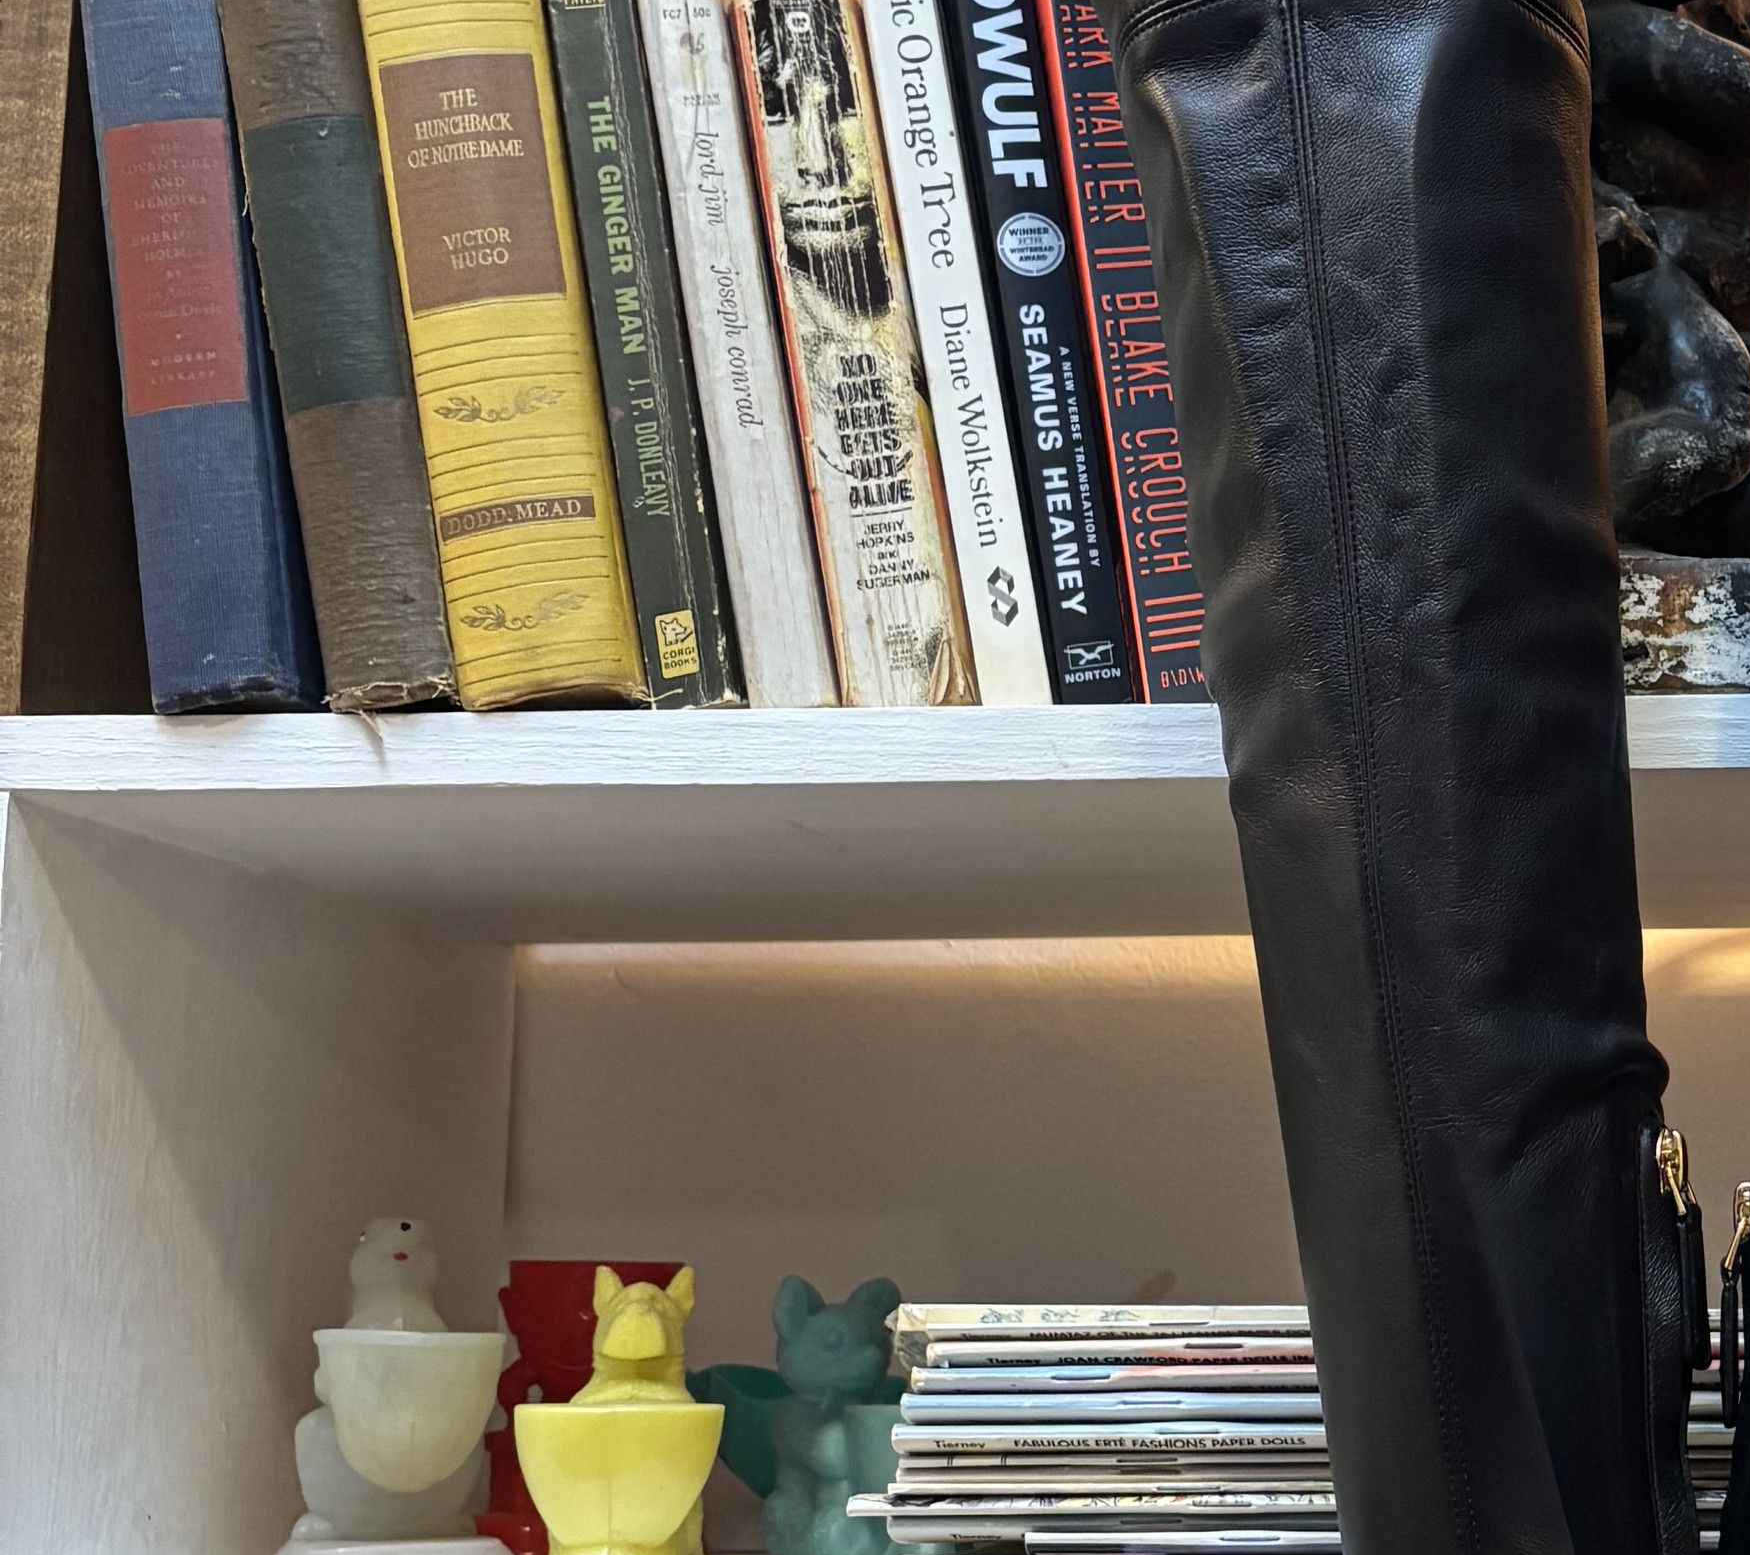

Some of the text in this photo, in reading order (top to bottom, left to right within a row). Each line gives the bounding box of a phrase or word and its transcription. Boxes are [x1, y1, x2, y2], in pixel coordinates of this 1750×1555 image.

[439, 88, 478, 110] THE
[414, 112, 514, 140] HUNCHBACK
[897, 34, 934, 169] Orange
[920, 171, 955, 269] Tree
[587, 96, 646, 355] THE GINGER MAN
[442, 227, 511, 250] VICTOR
[451, 248, 510, 270] HUGO
[940, 302, 1005, 548] Diane Wolkstein
[627, 378, 671, 517] J. P. DONLEAVY
[1019, 303, 1089, 616] SEAMUS HEANEY
[1059, 345, 1102, 568] A NEW VERSE TRANSLATION BY
[662, 646, 695, 660] CORGI
[664, 657, 697, 670] BOOKS
[1064, 667, 1122, 684] NORTON
[934, 1439, 986, 1451] Tierney
[1013, 1438, 1091, 1450] FABULOUS
[1131, 1437, 1207, 1451] FASHIONS
[1212, 1438, 1256, 1449] PAPER
[1260, 1437, 1307, 1447] DOLLS
